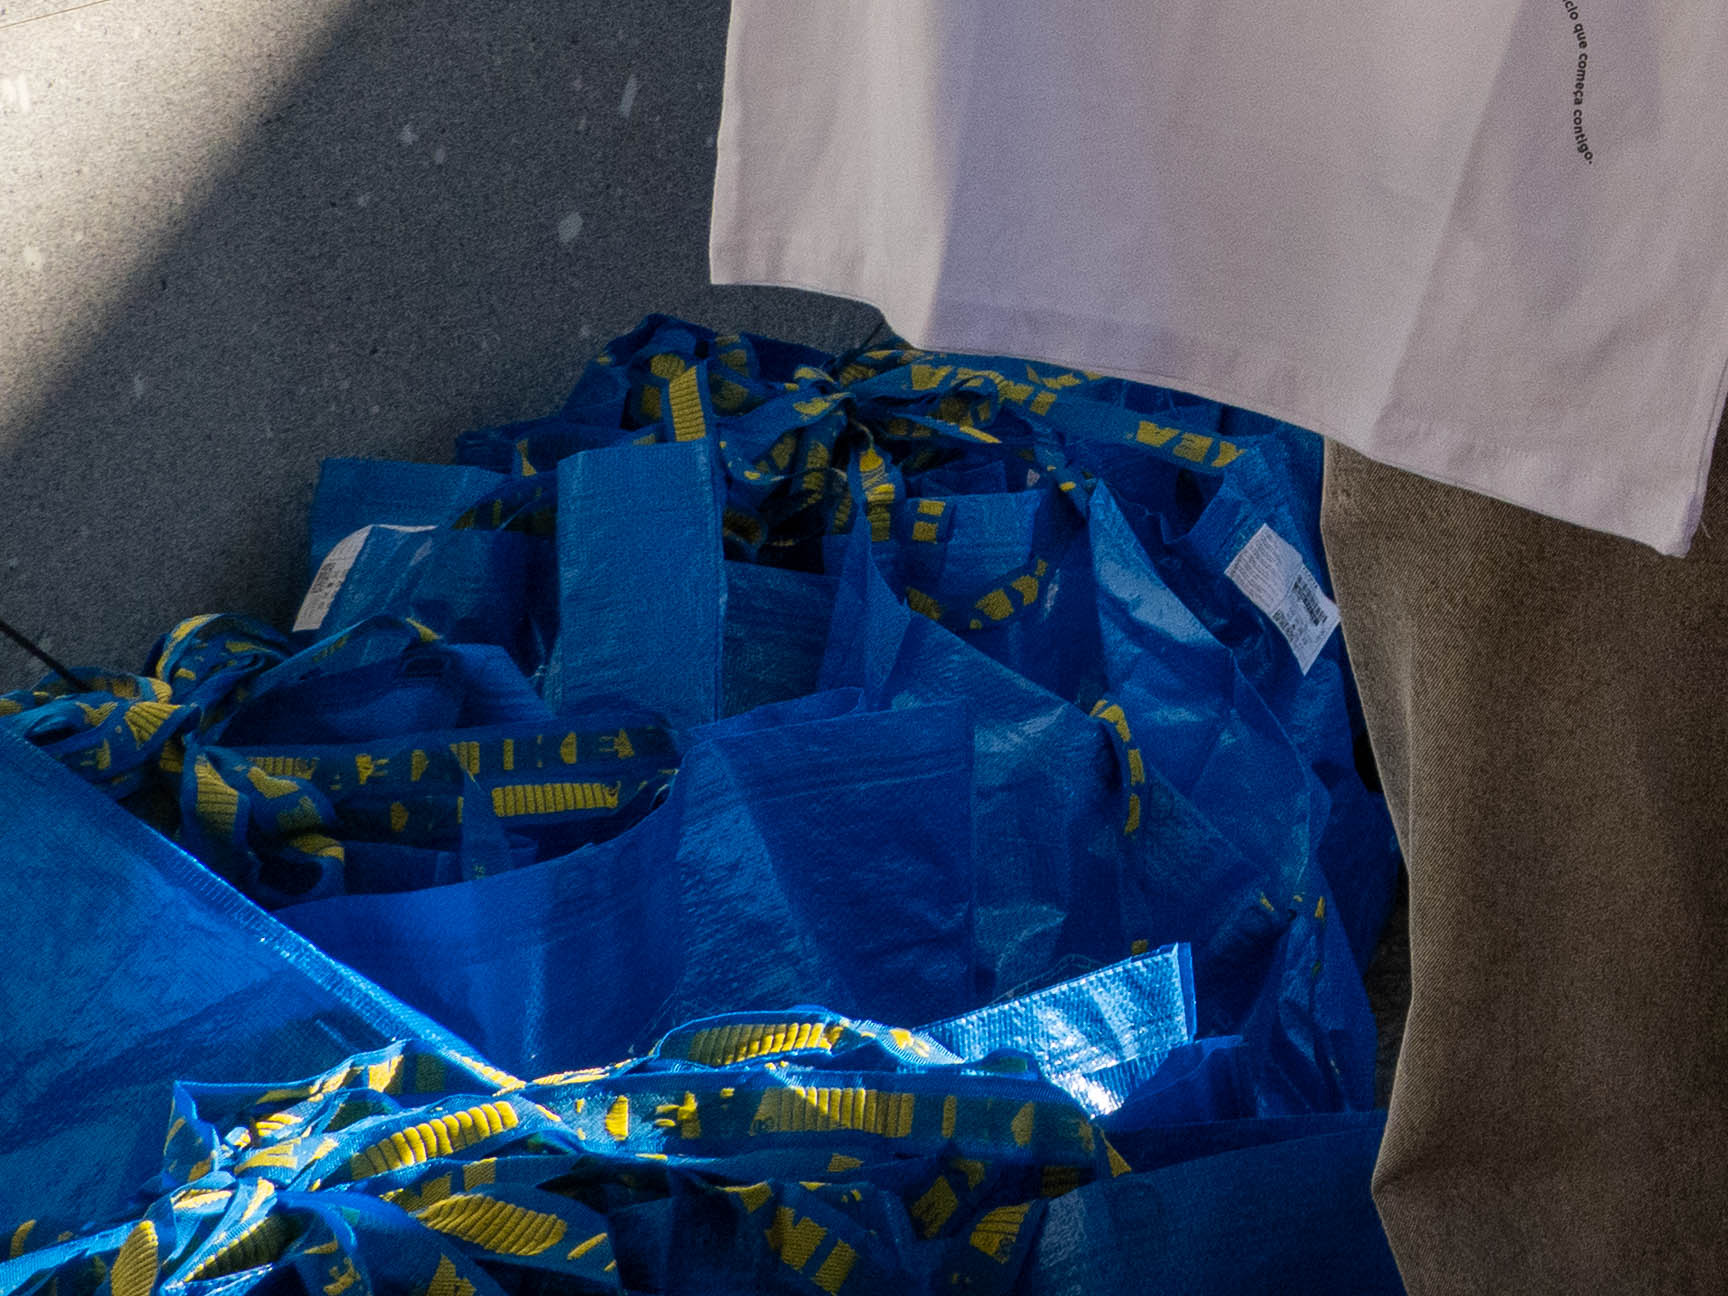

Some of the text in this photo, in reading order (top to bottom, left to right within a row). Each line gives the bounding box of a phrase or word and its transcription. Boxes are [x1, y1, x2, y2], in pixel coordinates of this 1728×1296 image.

[1574, 23, 1588, 49] que
[1573, 52, 1588, 106] começa
[1573, 108, 1594, 165] contigo.
